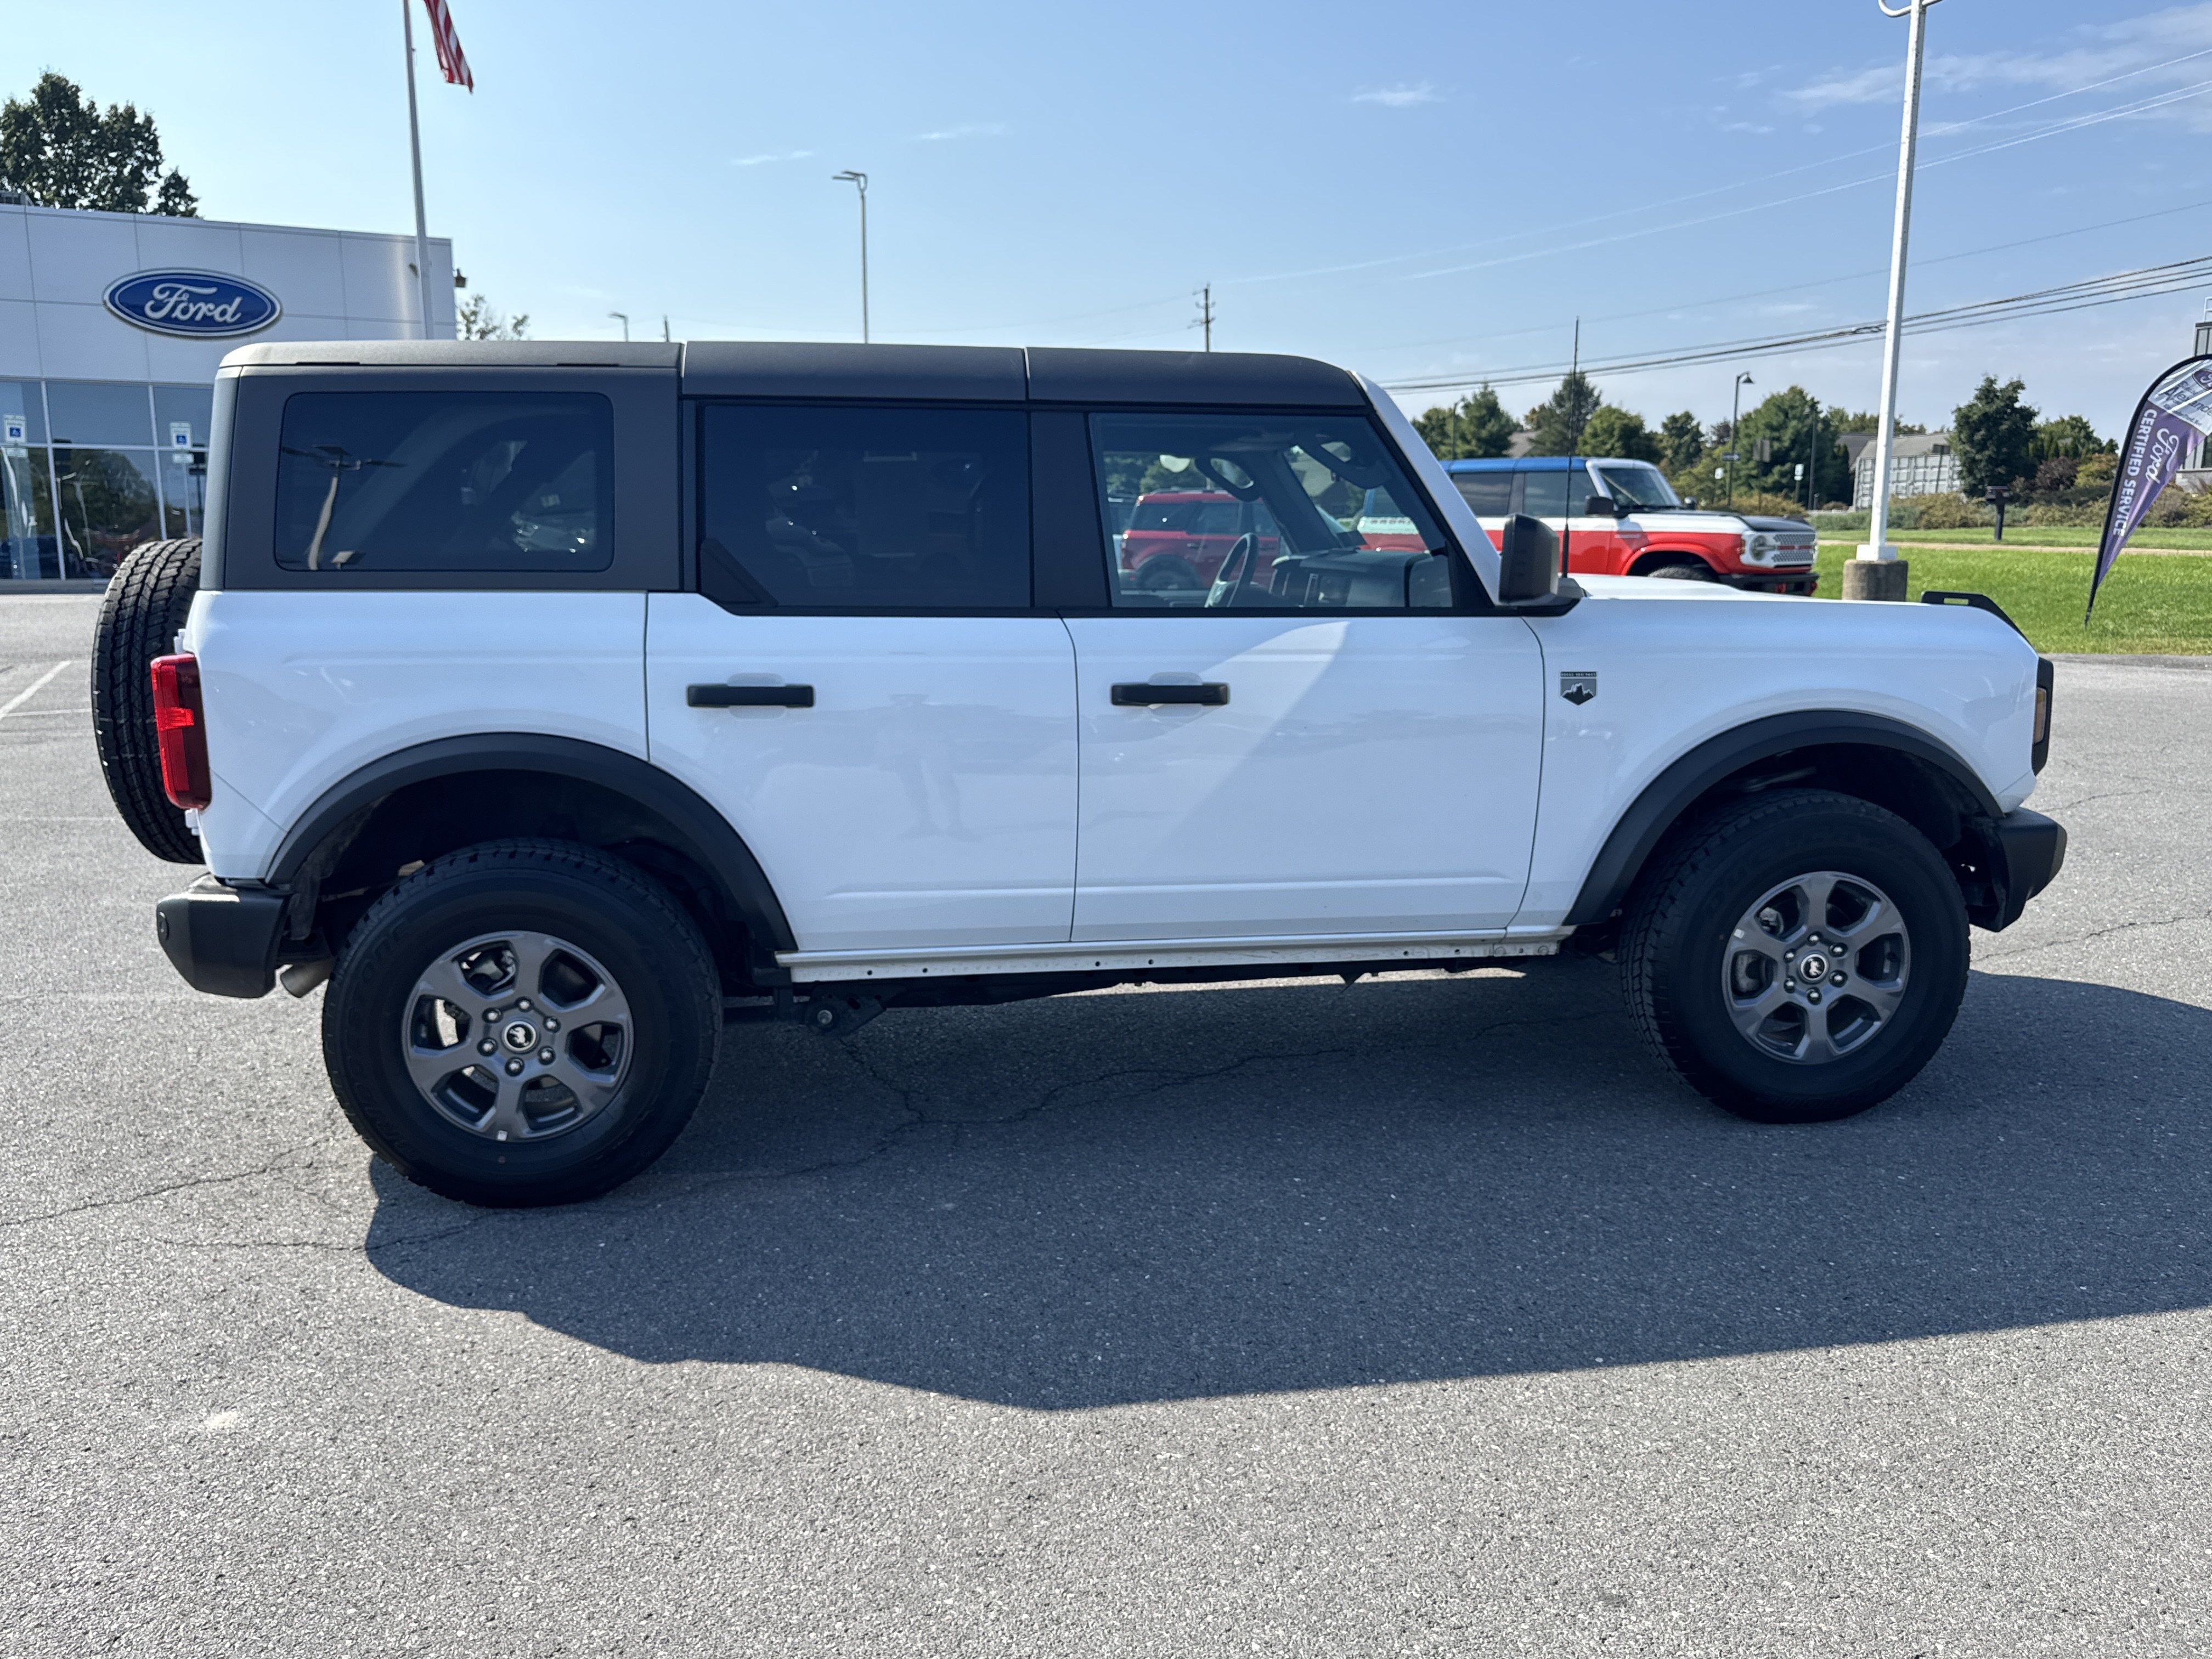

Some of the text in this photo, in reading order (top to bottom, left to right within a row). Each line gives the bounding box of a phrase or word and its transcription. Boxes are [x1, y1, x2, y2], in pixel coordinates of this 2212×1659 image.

[144, 282, 244, 324] Ford
[2113, 409, 2157, 537] CERTIFIED SERVICE
[2145, 428, 2180, 484] Ford
